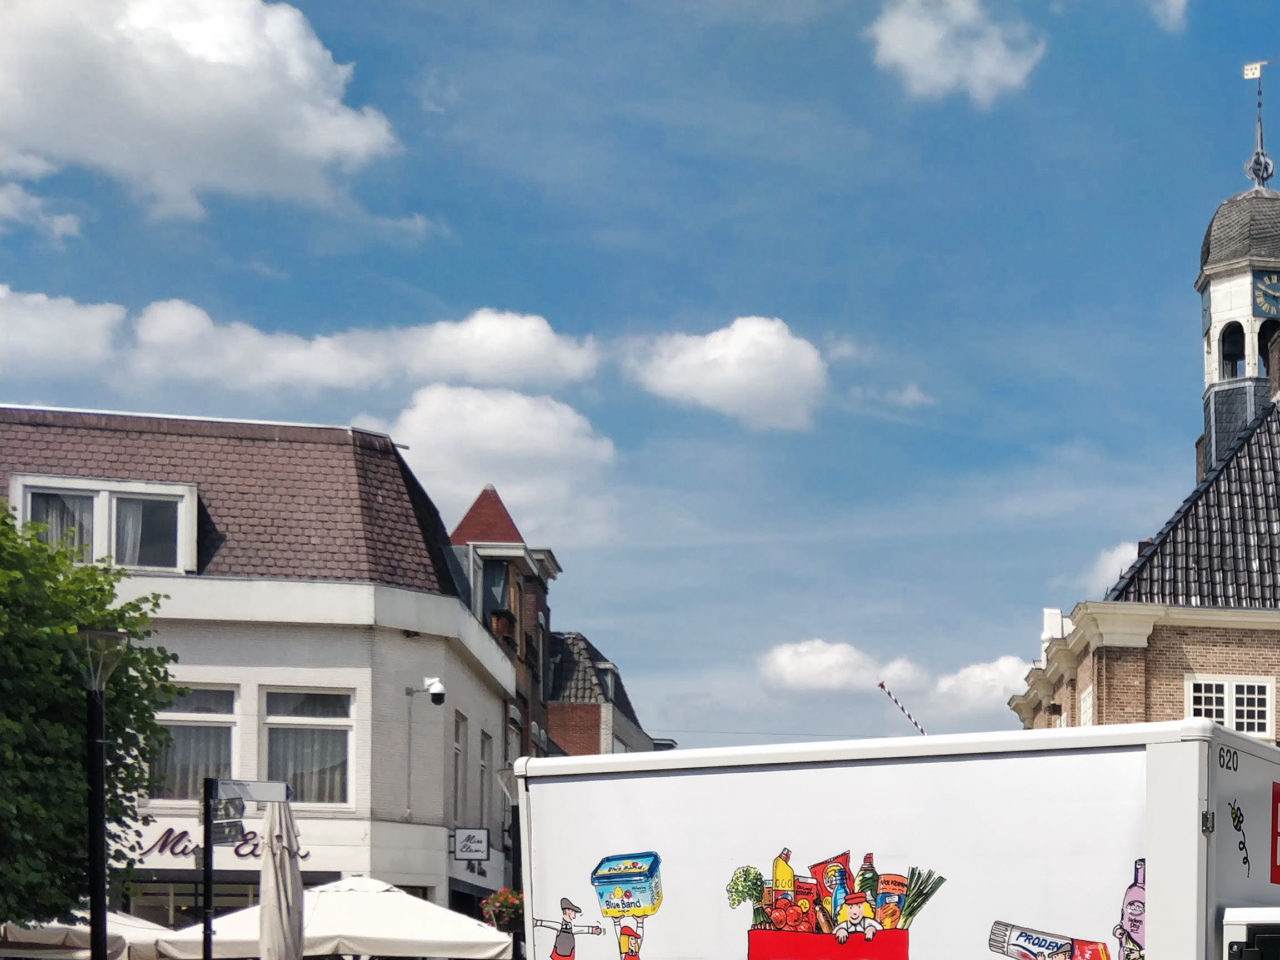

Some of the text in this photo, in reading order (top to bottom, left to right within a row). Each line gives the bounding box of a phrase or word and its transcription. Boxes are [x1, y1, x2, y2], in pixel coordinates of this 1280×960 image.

[1218, 747, 1239, 772] 620
[605, 899, 641, 909] Blue Band
[1016, 932, 1062, 951] PRODEN
